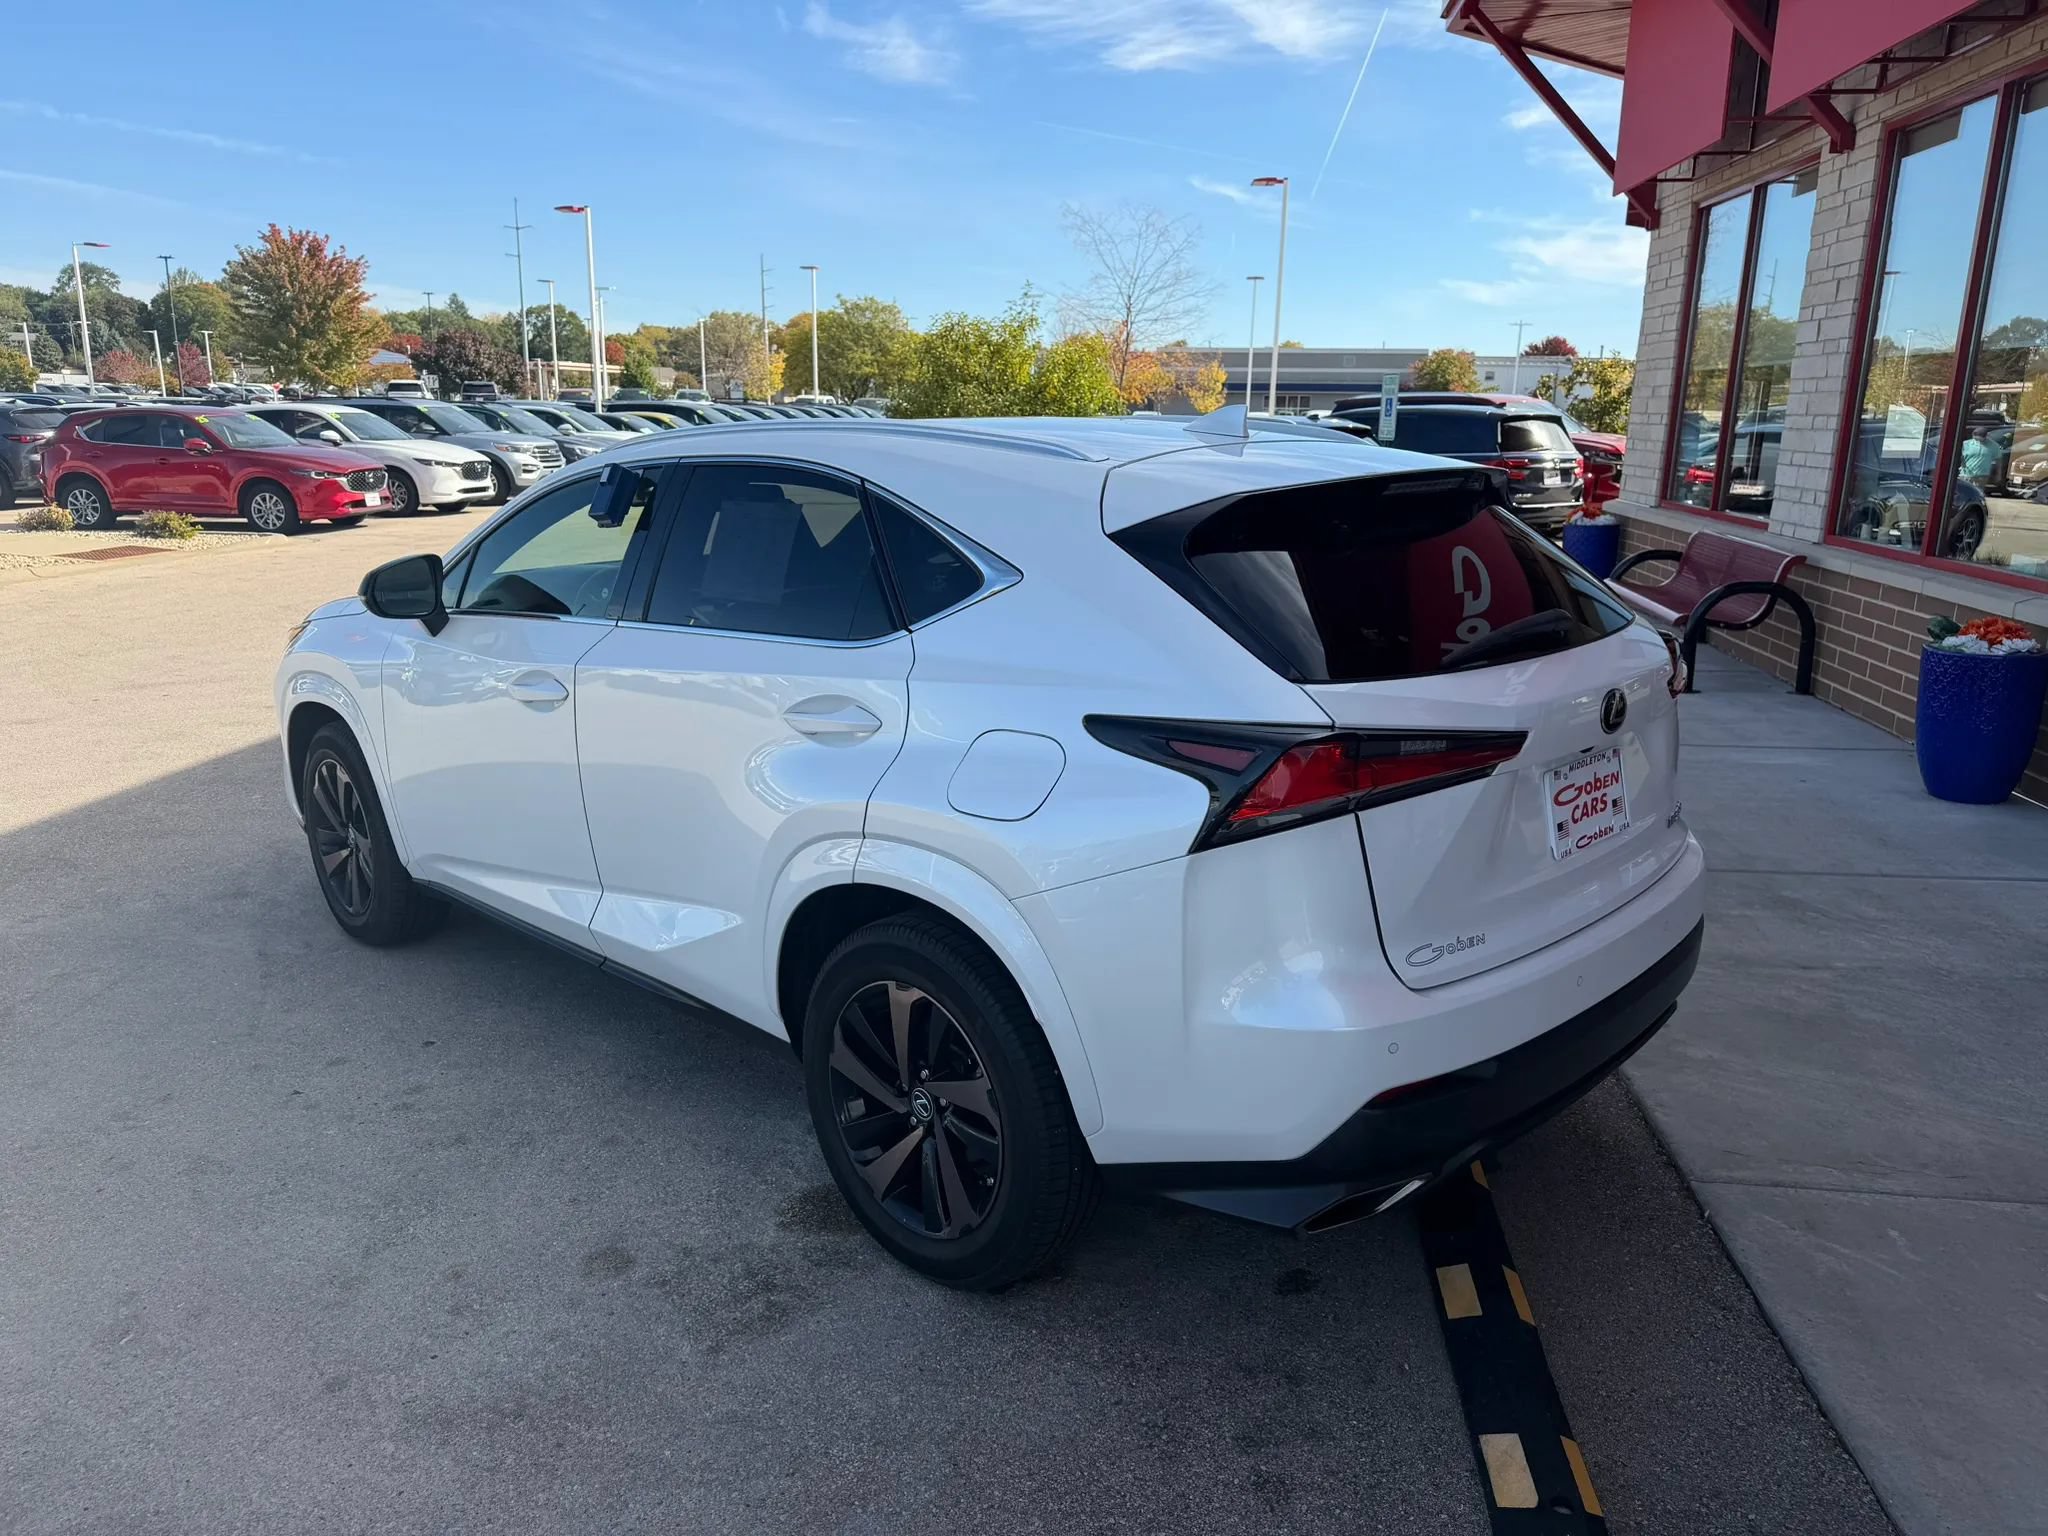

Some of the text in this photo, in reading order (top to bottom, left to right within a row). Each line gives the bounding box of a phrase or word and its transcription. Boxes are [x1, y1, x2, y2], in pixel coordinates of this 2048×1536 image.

[1568, 752, 1607, 773] MIDDLETON
[1571, 793, 1608, 824] CARS
[1560, 848, 1572, 859] USA
